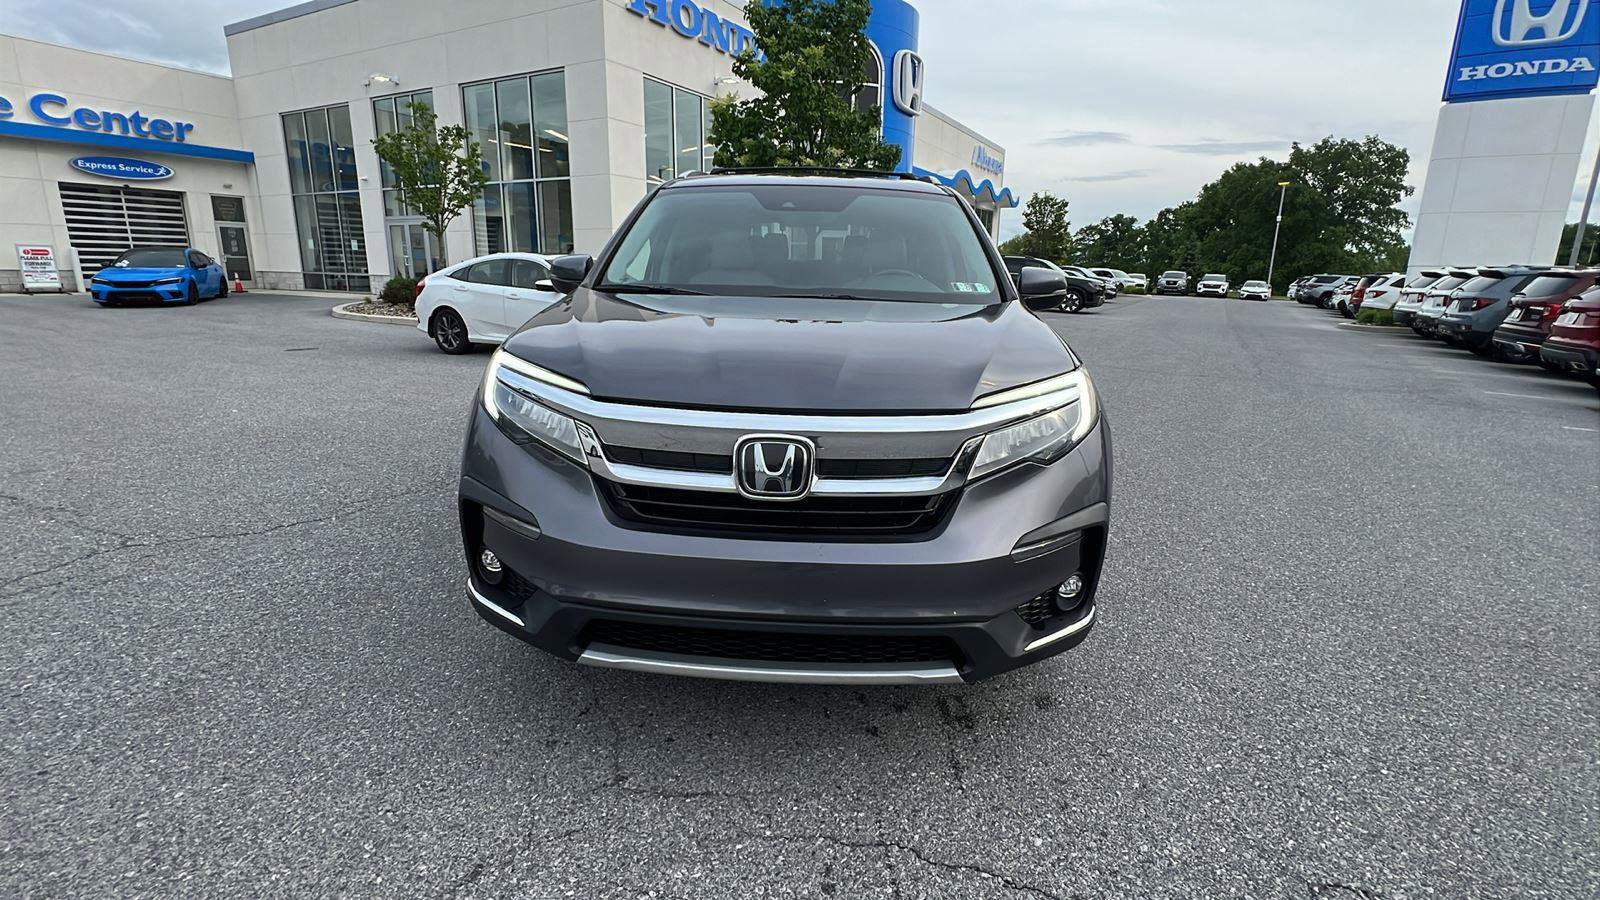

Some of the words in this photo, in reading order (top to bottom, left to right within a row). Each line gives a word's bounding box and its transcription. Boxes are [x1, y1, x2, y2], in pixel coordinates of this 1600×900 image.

[1458, 57, 1595, 81] HONDA
[29, 93, 194, 142] Center
[77, 159, 117, 170] Express
[118, 163, 154, 174] Service
